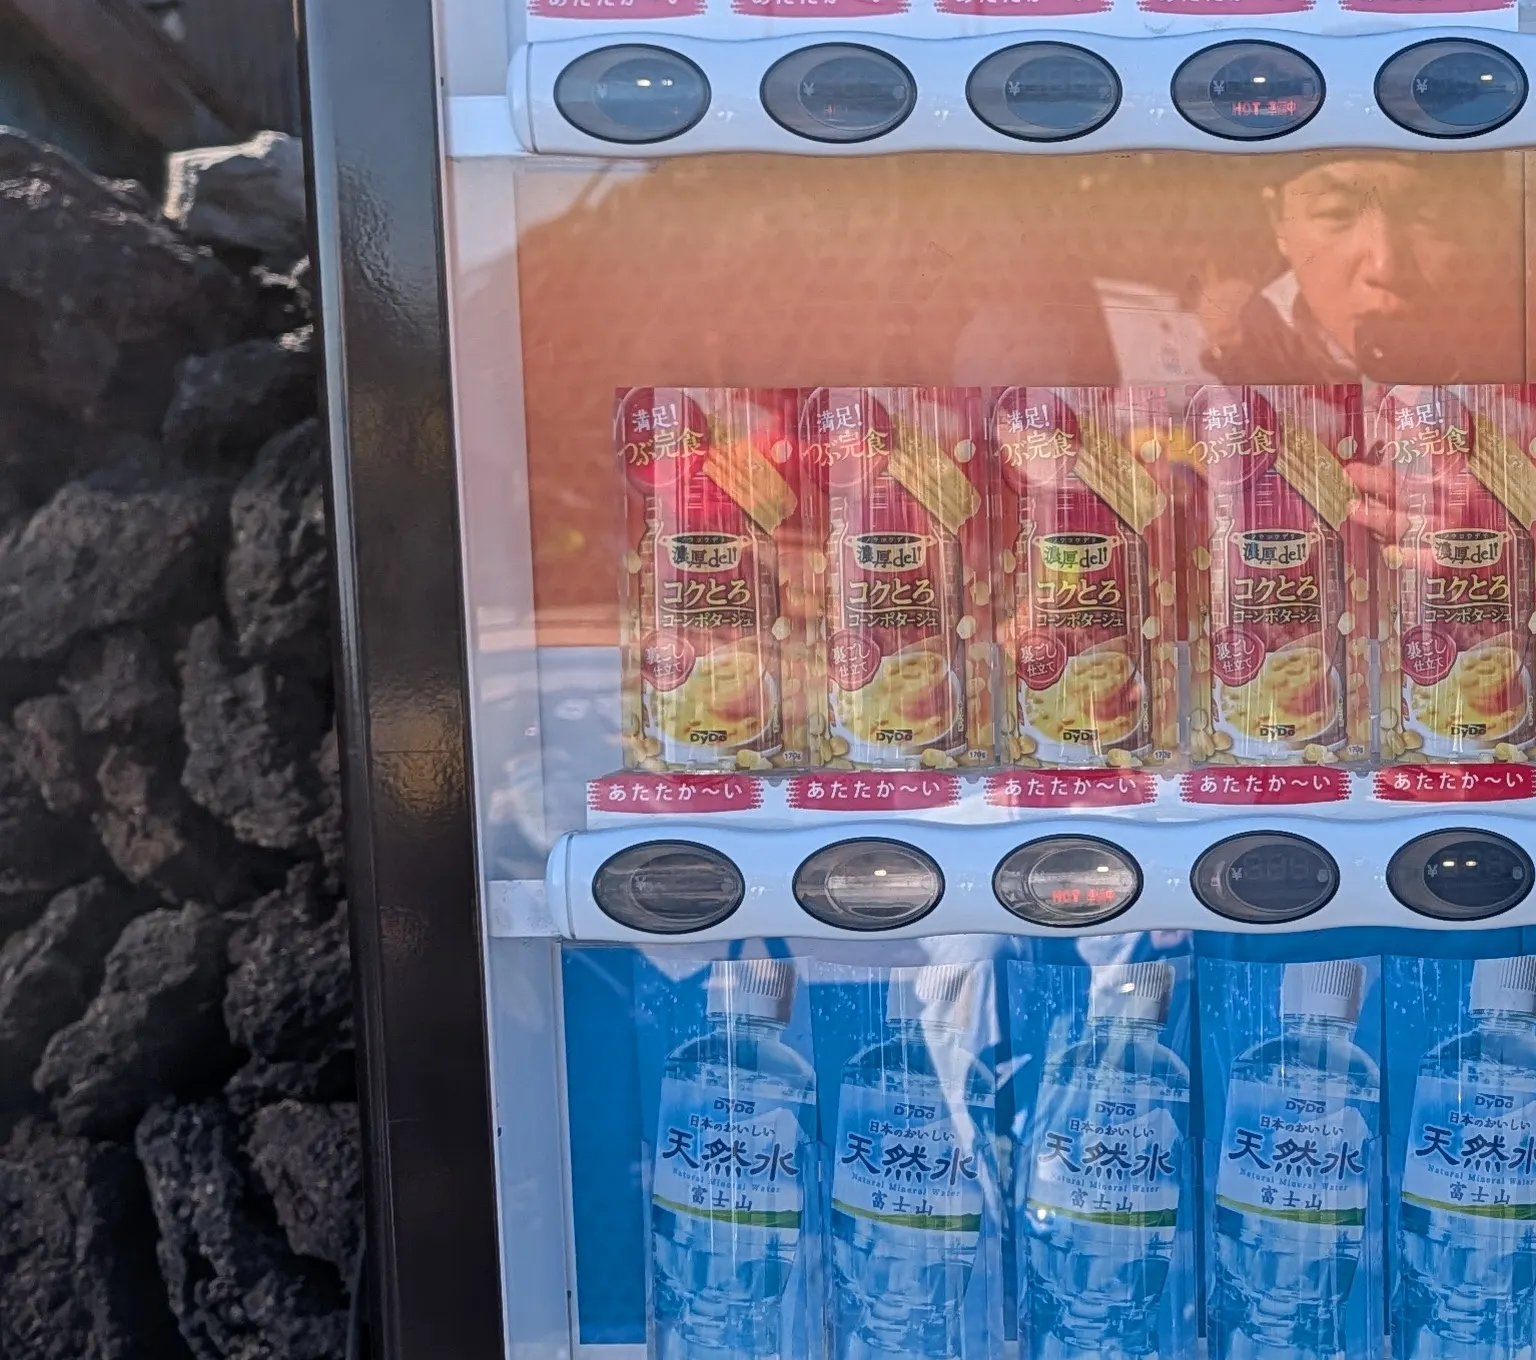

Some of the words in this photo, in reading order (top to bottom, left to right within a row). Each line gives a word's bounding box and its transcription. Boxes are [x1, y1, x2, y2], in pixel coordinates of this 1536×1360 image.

[849, 578, 935, 607] コクとろ
[1036, 578, 1121, 607] コクとろ
[1234, 576, 1319, 604] コクとろ
[1426, 576, 1510, 603] コクとろ
[662, 1127, 798, 1182] 天然水
[1038, 1130, 1175, 1186] 天然水
[1228, 1128, 1365, 1180] 天然水
